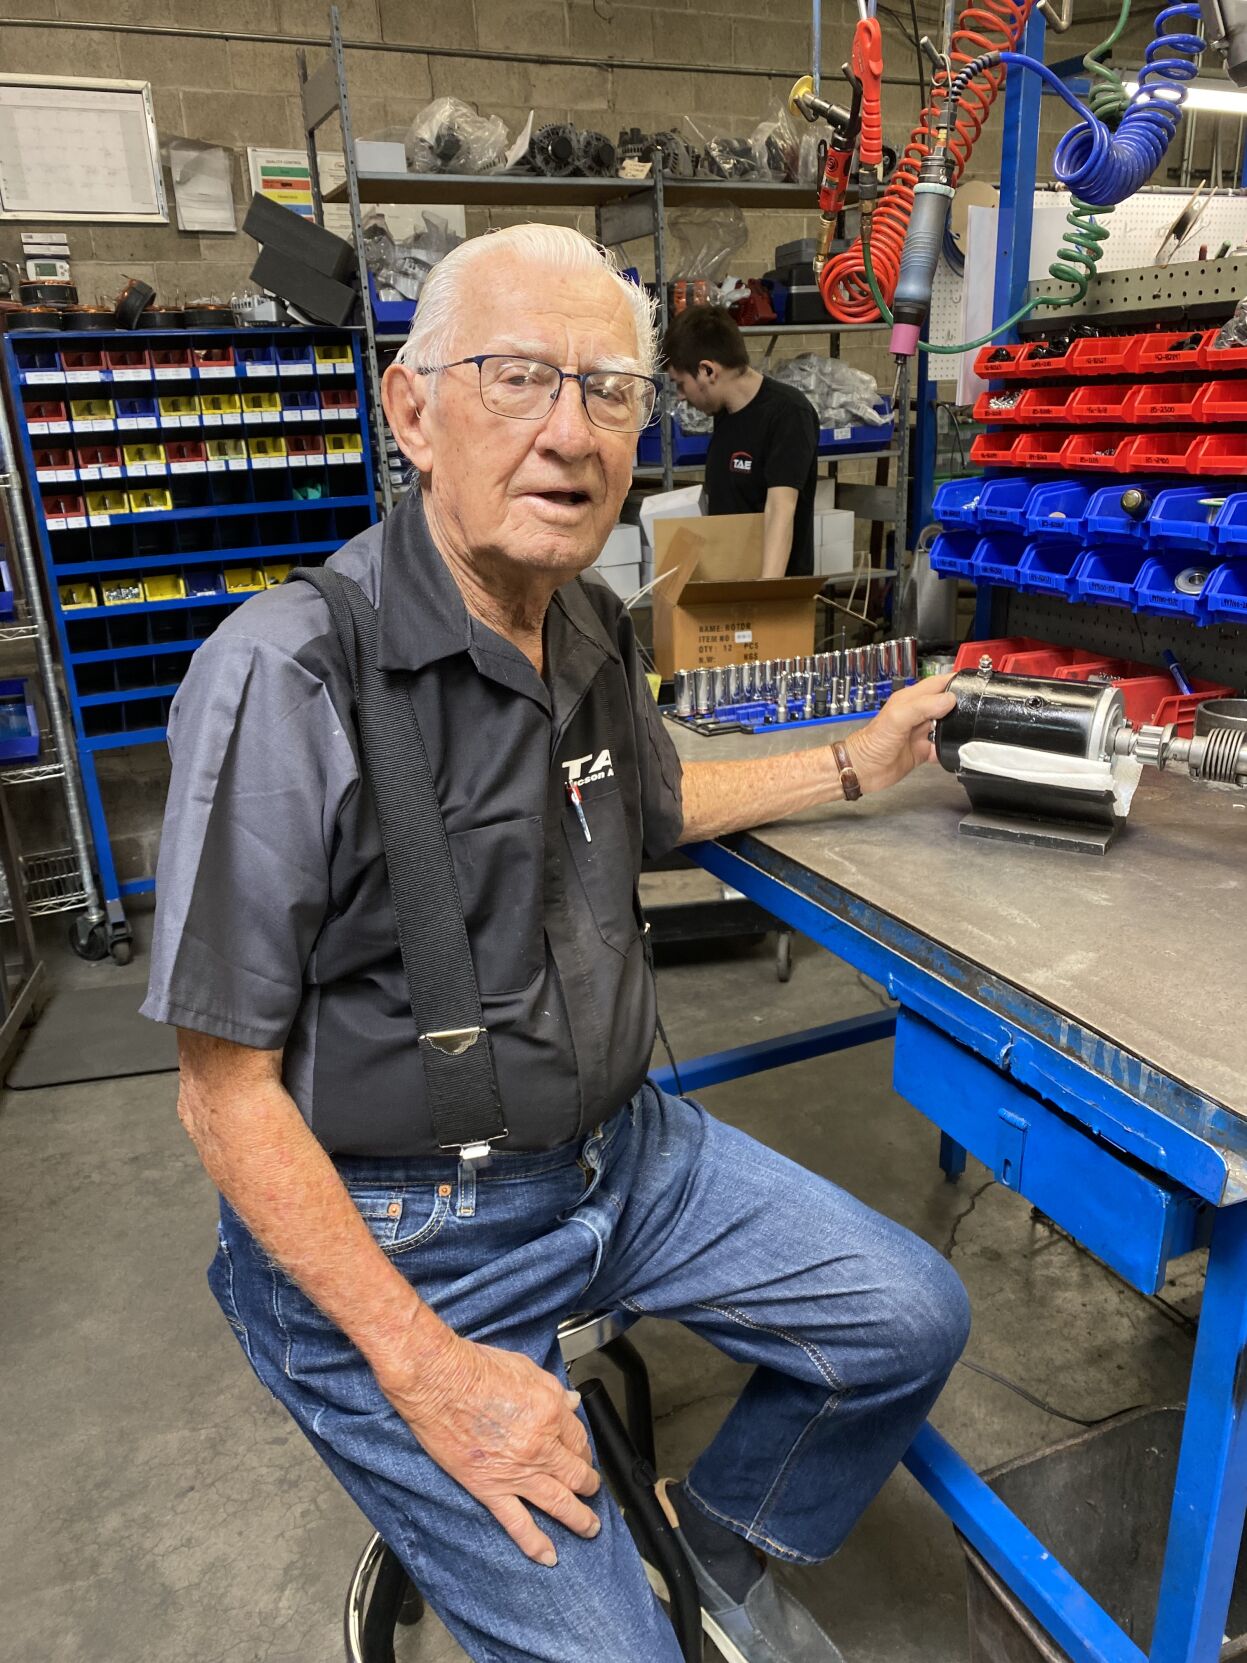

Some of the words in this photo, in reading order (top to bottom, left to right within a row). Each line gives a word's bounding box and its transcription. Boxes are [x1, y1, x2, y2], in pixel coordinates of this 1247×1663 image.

[733, 460, 753, 470] TAE
[723, 644, 733, 652] 12
[743, 642, 759, 650] PCS
